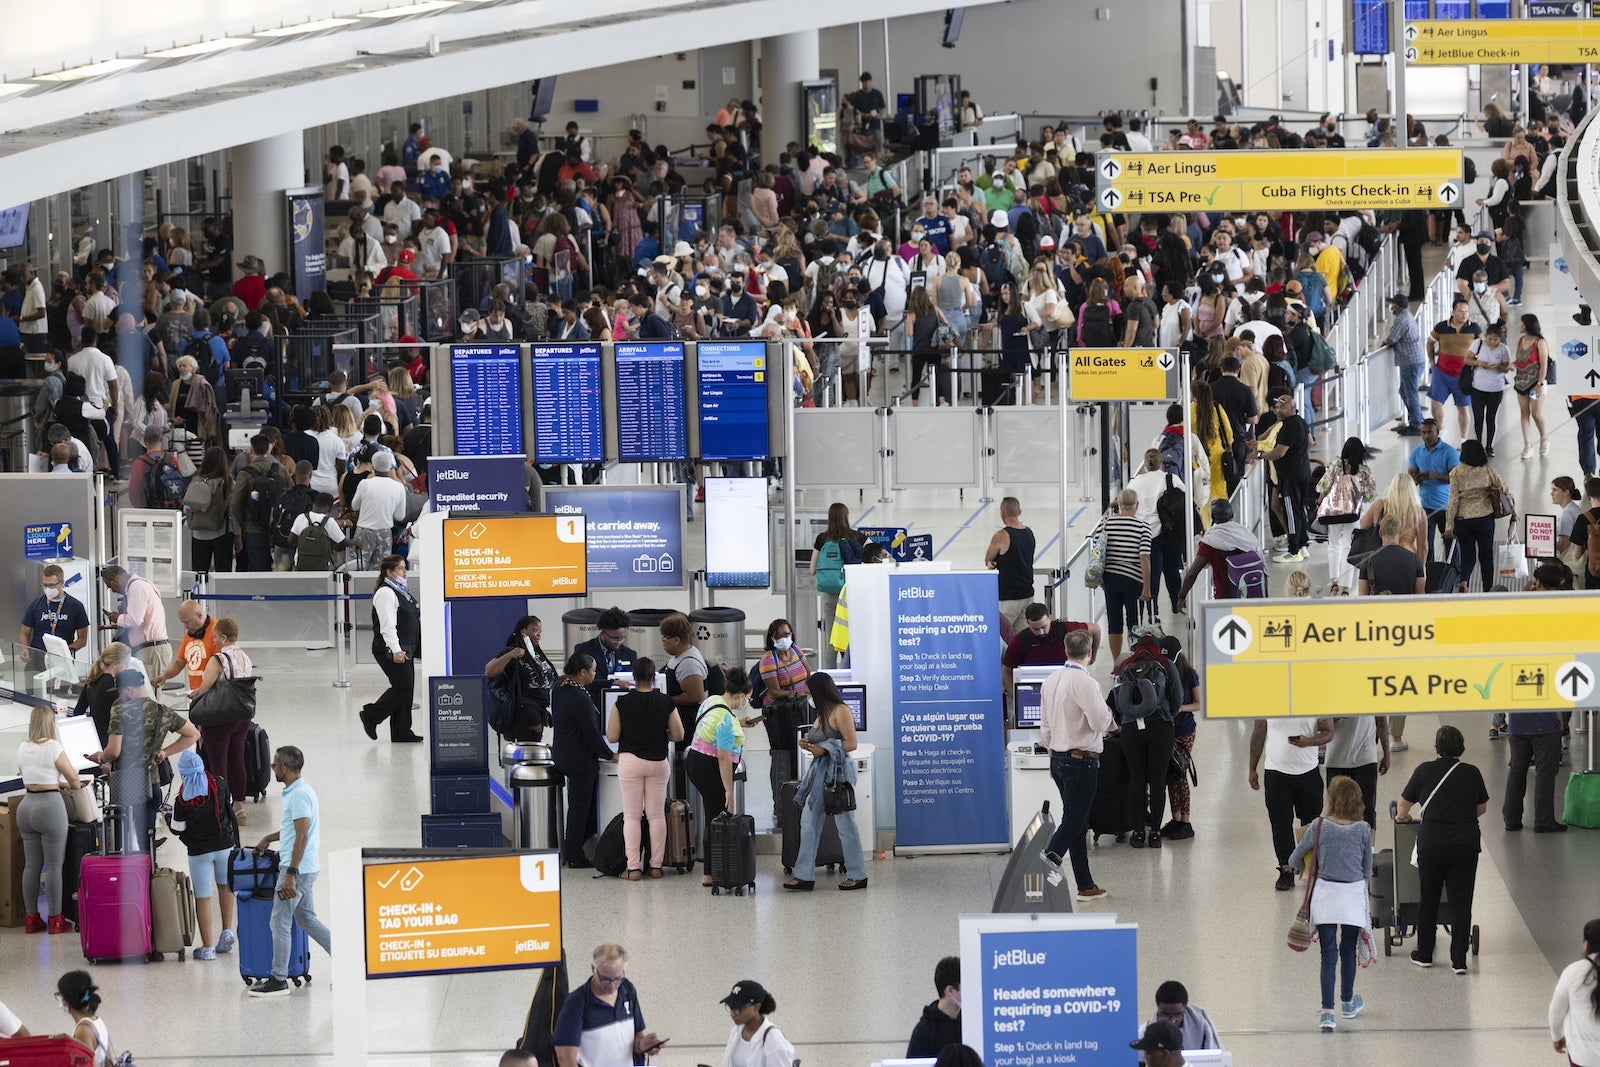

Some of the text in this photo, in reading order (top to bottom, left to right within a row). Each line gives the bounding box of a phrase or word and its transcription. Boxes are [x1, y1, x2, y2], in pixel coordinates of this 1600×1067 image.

[1532, 6, 1560, 15] TSA Pre
[1438, 27, 1488, 38] Aer Lingus
[1438, 48, 1520, 58] JetBlue Check-in
[1578, 48, 1598, 56] TSA
[1148, 162, 1217, 176] Aer Lingus
[1148, 191, 1202, 204] TSA Pre
[1262, 184, 1410, 200] Cuba Flights Check-in
[1075, 356, 1126, 367] All Gates
[436, 470, 470, 482] jetBlue
[436, 492, 508, 502] Expedited security
[437, 503, 480, 511] has moved.
[567, 520, 575, 535] 1
[598, 520, 660, 532] carried away.
[454, 548, 493, 557] CHECK-IN
[454, 556, 511, 566] TAG YOUR BAG
[454, 581, 487, 589] ETIQUETE
[552, 576, 578, 587] jetBlue
[898, 587, 934, 601] jetBlue
[898, 613, 984, 623] Headed somewhere
[898, 626, 939, 636] requiring
[948, 624, 988, 634] COVID-19
[1302, 620, 1435, 647] Aer Lingus
[898, 637, 920, 646] test?
[1367, 674, 1468, 697] TSA Pre
[901, 713, 915, 723] ¿Va
[923, 712, 945, 722] algún
[947, 713, 968, 722] lugar
[969, 713, 984, 721] que
[901, 724, 936, 733] requiere
[954, 723, 982, 732] prueba
[913, 734, 955, 742] COVID-19?
[925, 779, 950, 787] Verifique
[535, 860, 545, 880] 1
[379, 902, 442, 917] CHECK-IN +
[379, 914, 458, 929] TAG YOUR BAG
[380, 939, 424, 950] CHECK-IN
[515, 939, 550, 954] jetBlue
[380, 946, 485, 962] ETIQUETE SU EQUIPAJE
[993, 950, 1046, 969] jetBlue
[994, 985, 1116, 1000] Headed somewhere
[994, 1000, 1121, 1018] requiring a COVID-19
[994, 1020, 1025, 1032] test?
[994, 1040, 1098, 1053] Step 1: Check in tag
[994, 1057, 1014, 1067] your
[1036, 1056, 1044, 1064] at
[1054, 1053, 1076, 1064] kiosk
